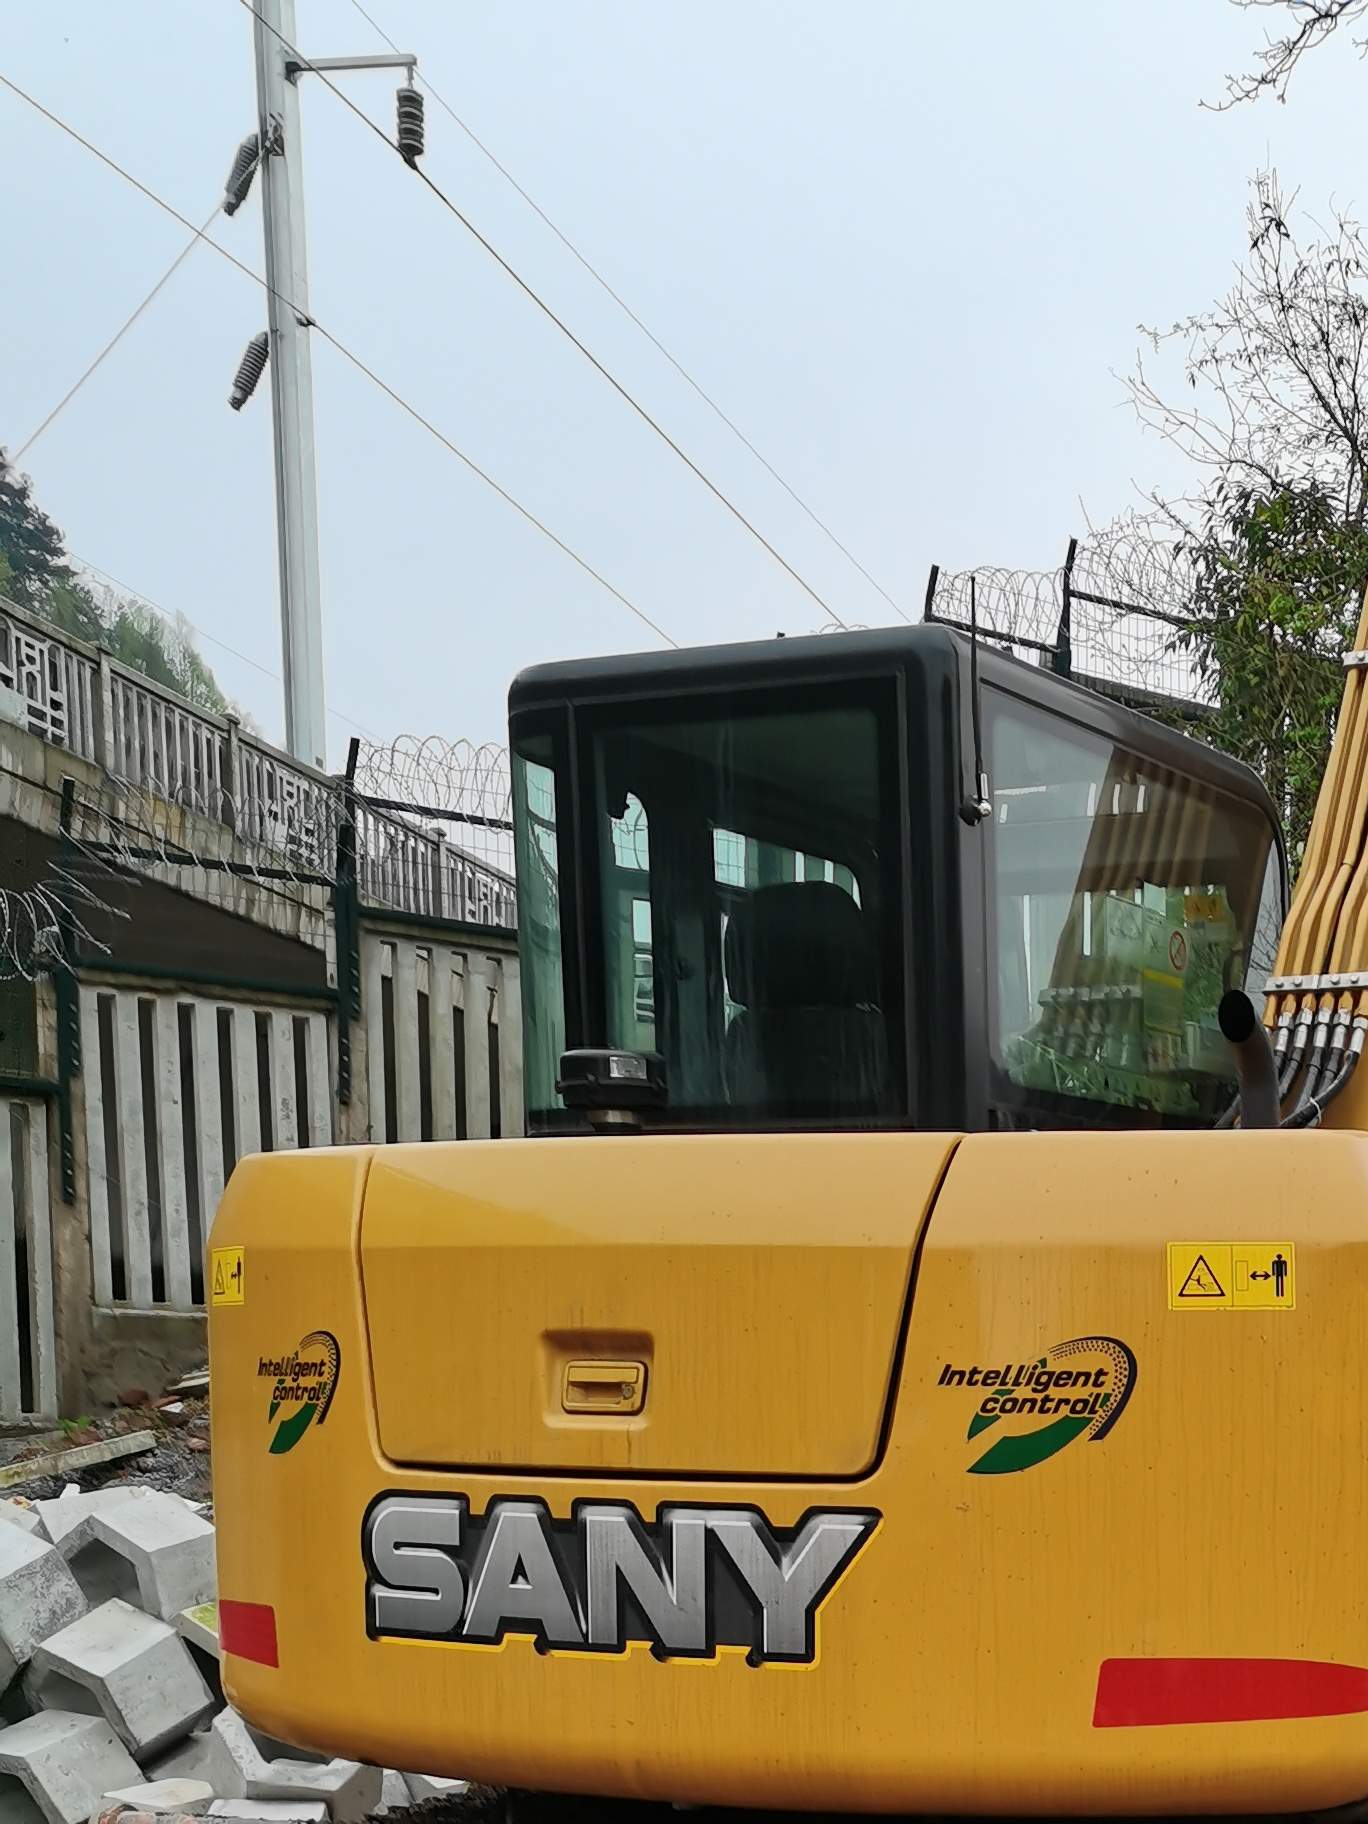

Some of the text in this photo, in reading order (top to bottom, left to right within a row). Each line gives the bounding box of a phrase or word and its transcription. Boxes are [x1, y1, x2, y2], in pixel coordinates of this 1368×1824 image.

[257, 1357, 326, 1382] Intelligent
[937, 1364, 1109, 1393] Intelligent
[273, 1382, 323, 1401] control
[980, 1392, 1102, 1415] control
[364, 1491, 884, 1668] SANY
